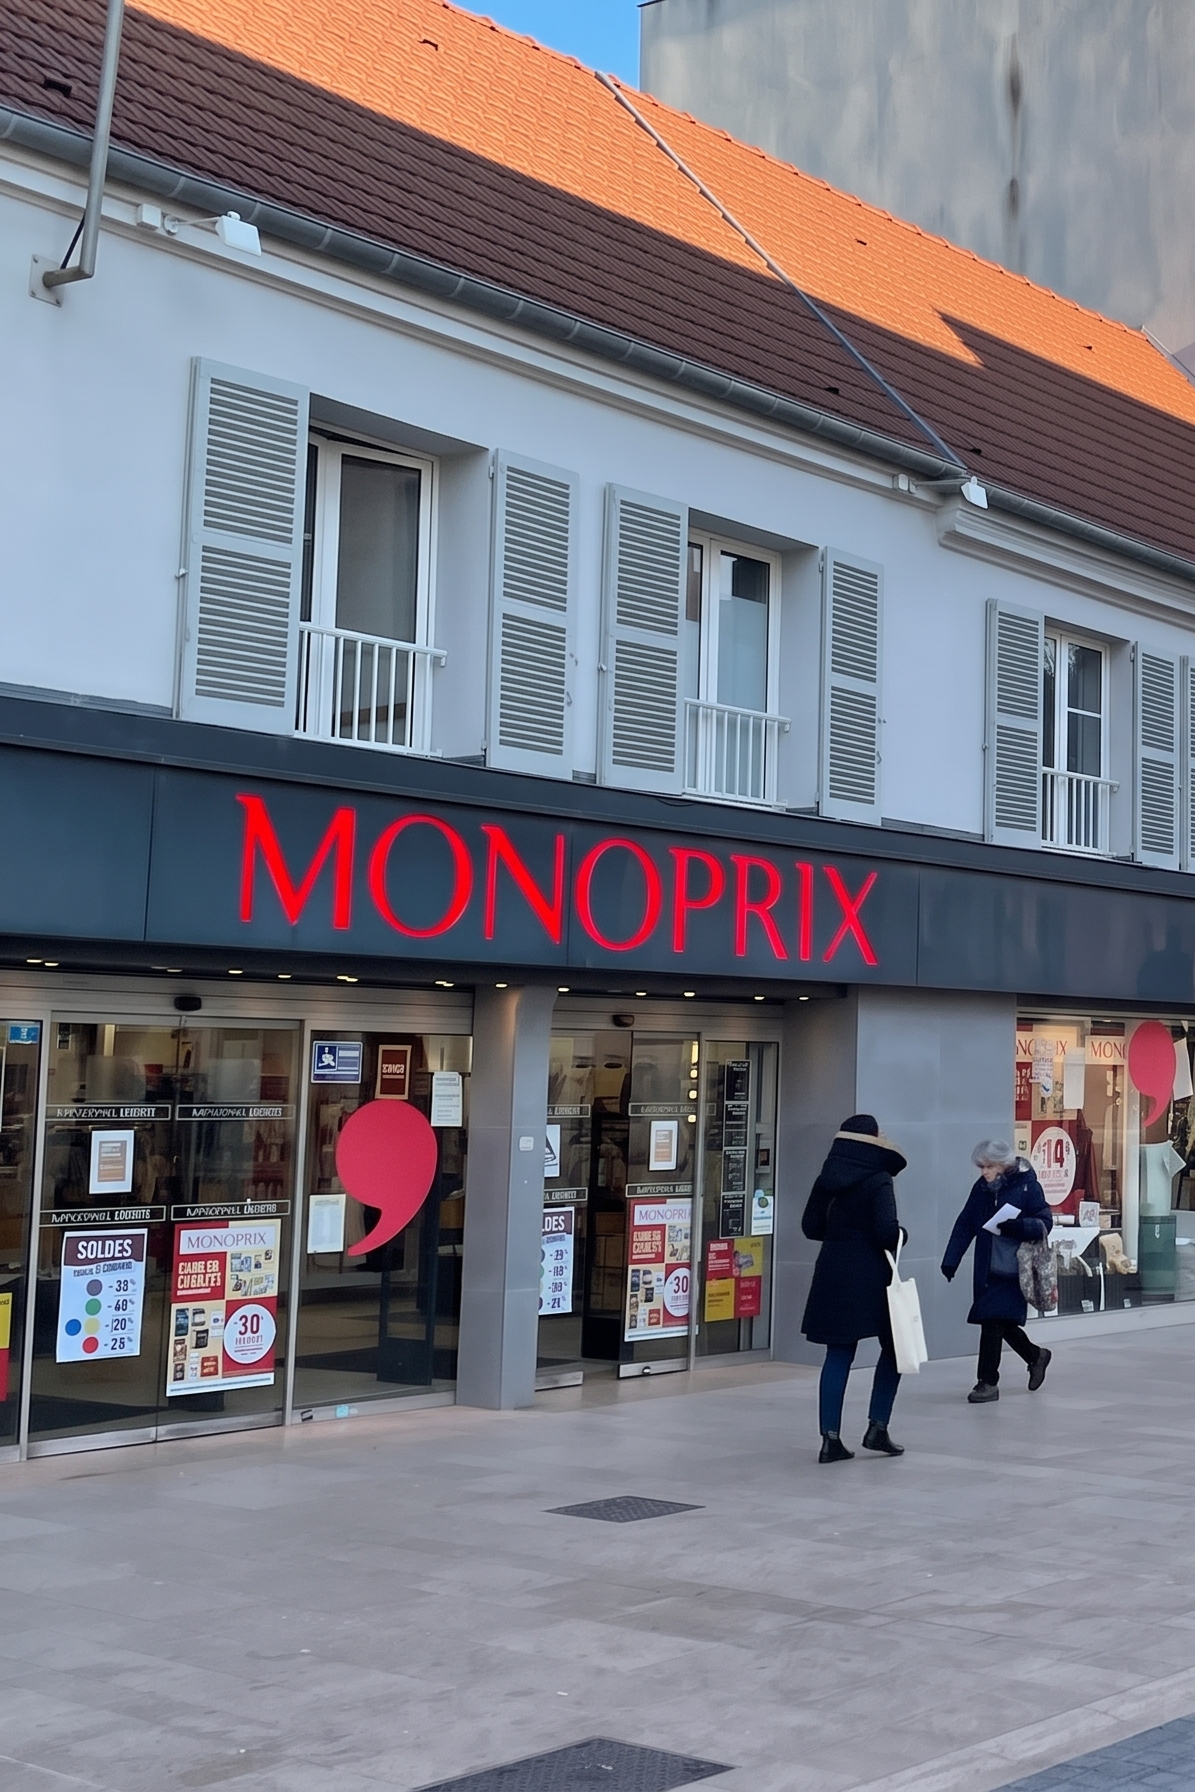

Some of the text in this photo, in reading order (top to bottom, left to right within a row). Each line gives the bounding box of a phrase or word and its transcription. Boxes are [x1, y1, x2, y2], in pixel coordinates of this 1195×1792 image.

[235, 793, 878, 966] MONOPRIX
[77, 1239, 133, 1259] SOLDES
[187, 1232, 267, 1249] MONOPRIX
